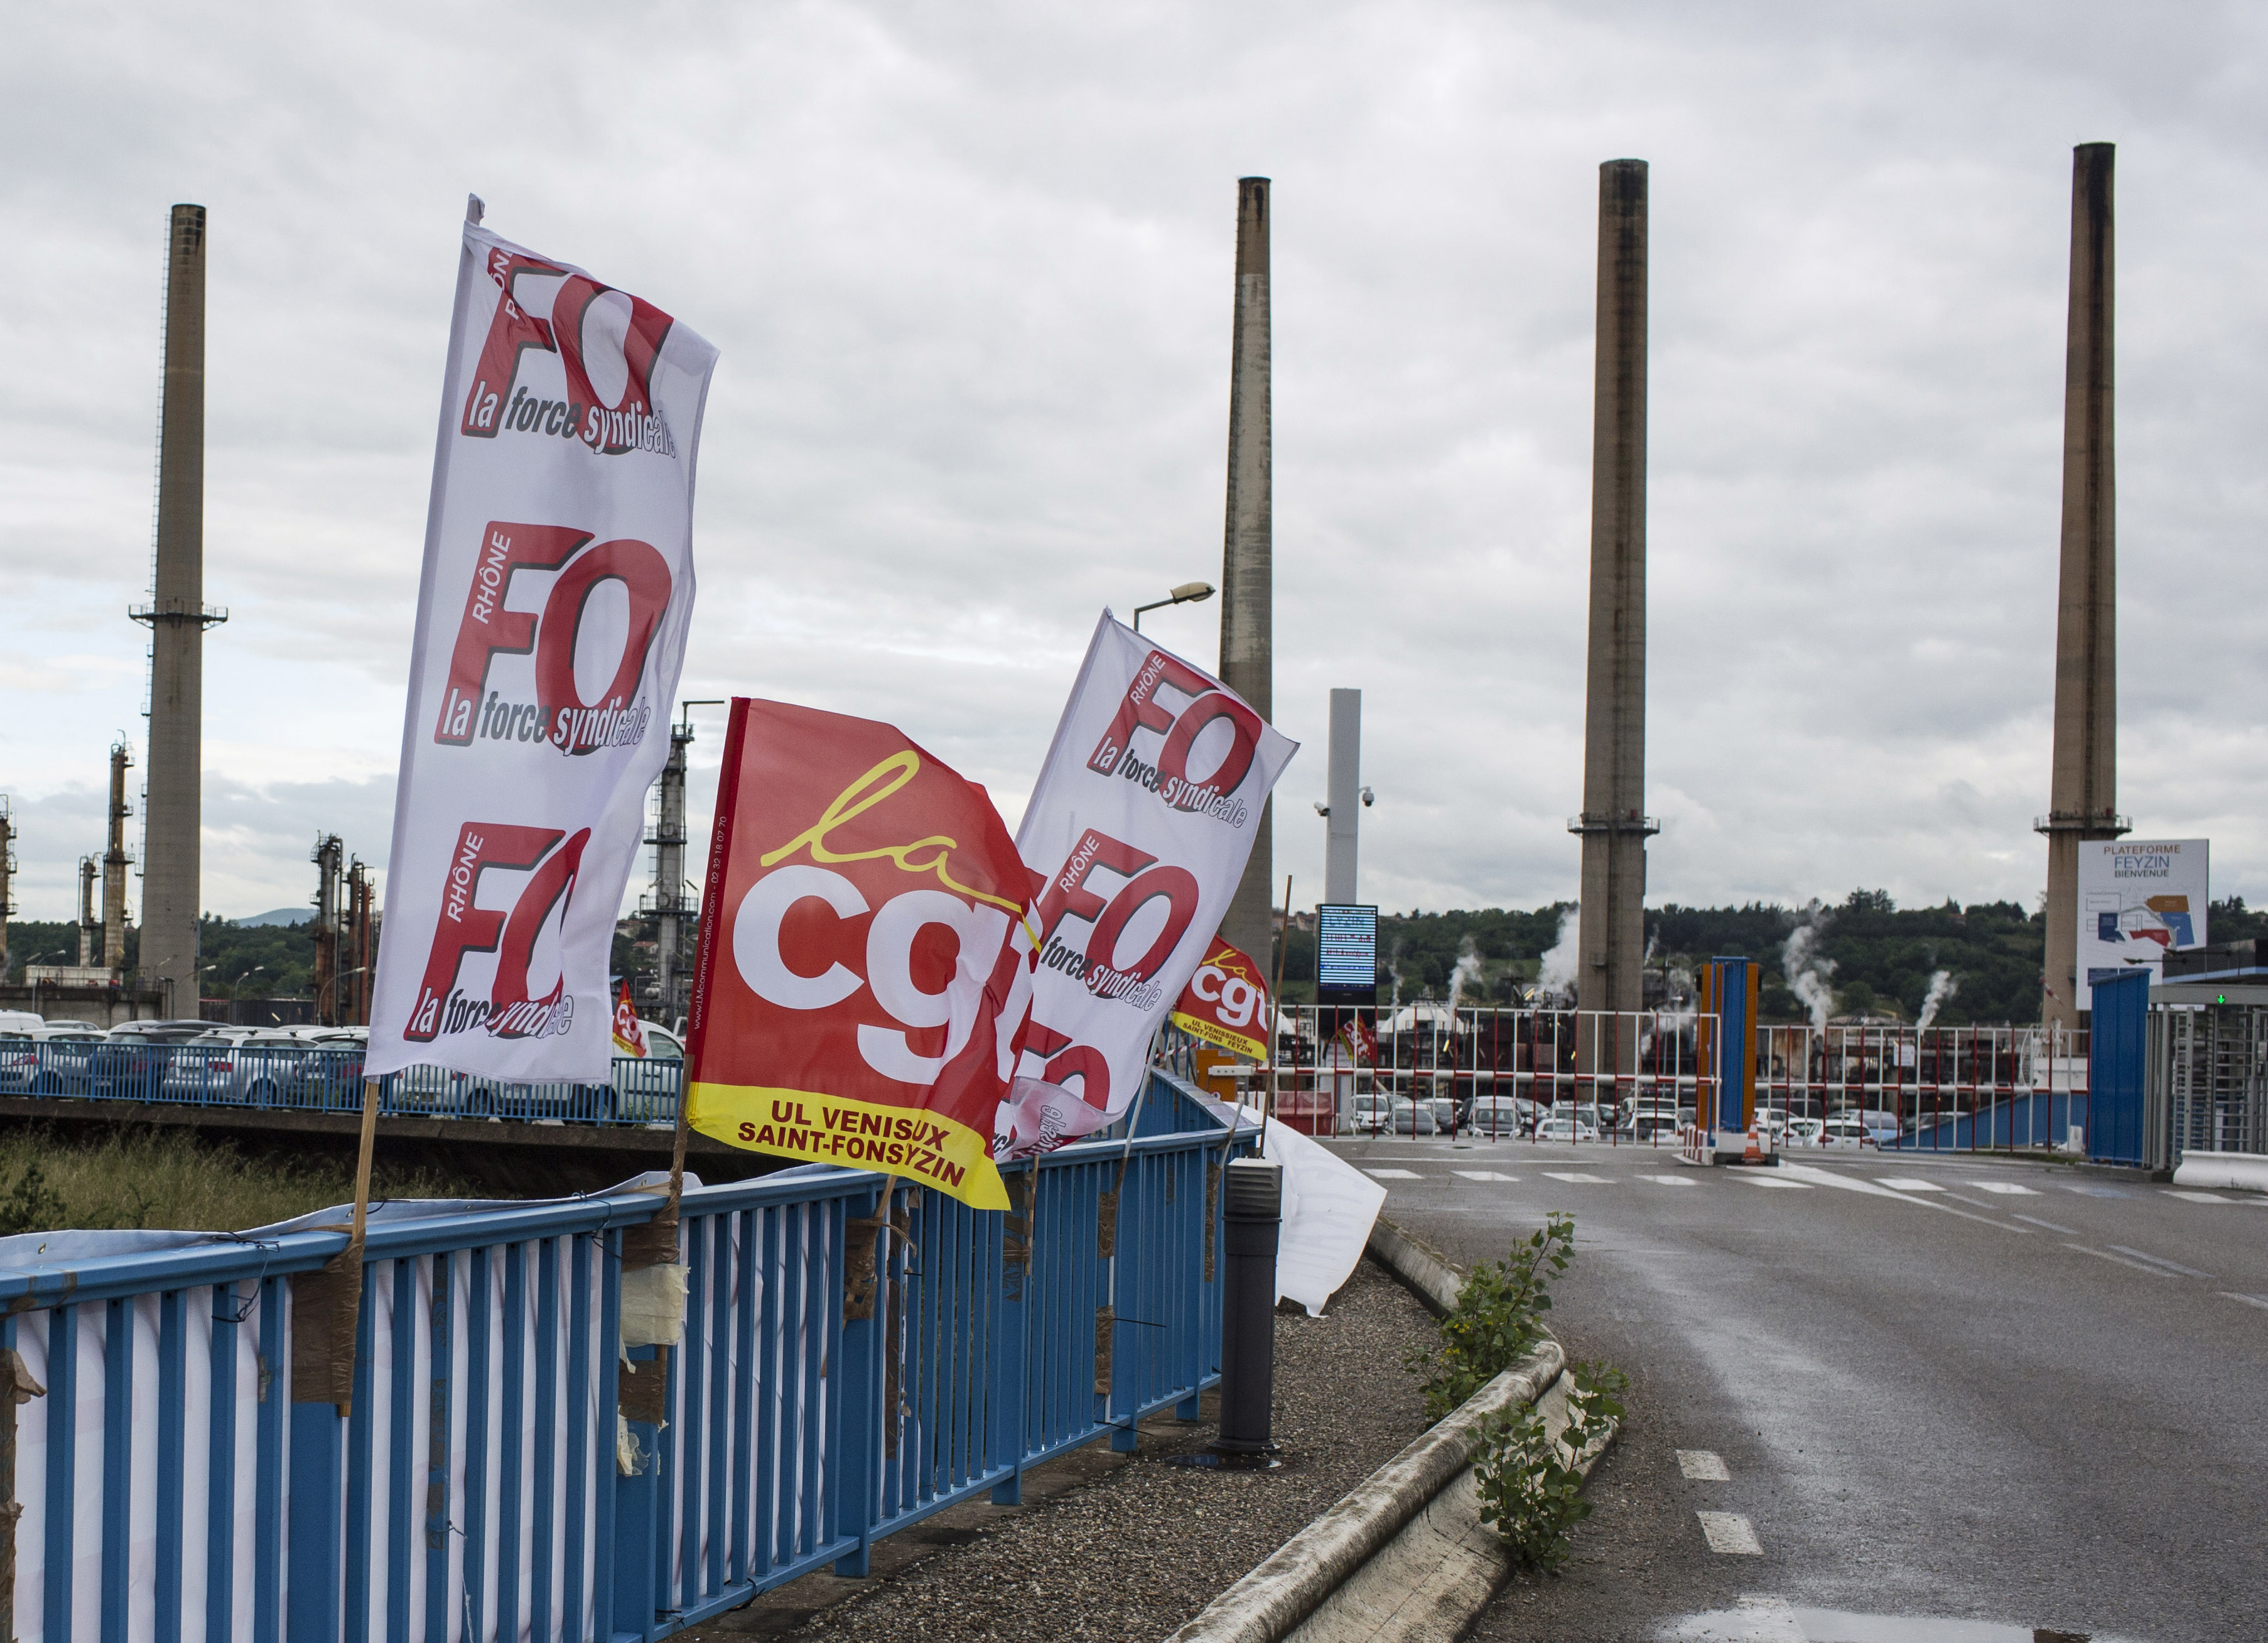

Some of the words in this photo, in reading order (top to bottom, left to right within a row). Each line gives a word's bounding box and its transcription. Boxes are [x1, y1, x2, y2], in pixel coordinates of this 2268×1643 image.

[462, 247, 674, 455] FO
[468, 380, 498, 428] la
[504, 386, 580, 438] force
[472, 531, 511, 624] RHÔNE
[434, 521, 672, 756] FO
[1130, 655, 1165, 705] RHÔNE
[441, 688, 472, 736] la
[480, 691, 551, 743] force
[553, 696, 651, 756] syndicale
[1086, 649, 1262, 812] FO
[1093, 736, 1118, 769] la
[1117, 749, 1166, 793] force
[1162, 776, 1248, 828] syndicale
[715, 844, 723, 854] 18
[716, 830, 725, 842] 07
[719, 816, 727, 828] 70
[2103, 845, 2181, 855] PLATEFORME
[447, 831, 484, 923] RHÔNE
[711, 872, 719, 884] 02
[713, 858, 721, 869] 32
[760, 751, 1042, 953] la
[1059, 835, 1100, 893] RHÔNE
[2115, 855, 2170, 869] FEYZIN
[2115, 869, 2169, 878] BIENVENUE
[403, 822, 591, 1043] FO
[1037, 828, 1199, 999] FO
[733, 865, 1043, 1085] cgt
[1040, 936, 1093, 980] force
[1087, 963, 1162, 1012] syndicale
[1191, 965, 1267, 1032] cgt
[411, 987, 439, 1033] la
[1182, 1022, 1223, 1043] SAINT-FONS
[1227, 1040, 1253, 1054] FEYZIN
[1192, 1019, 1201, 1029] UL
[1204, 1023, 1248, 1045] VENISSIEUX
[771, 1100, 812, 1126] UL
